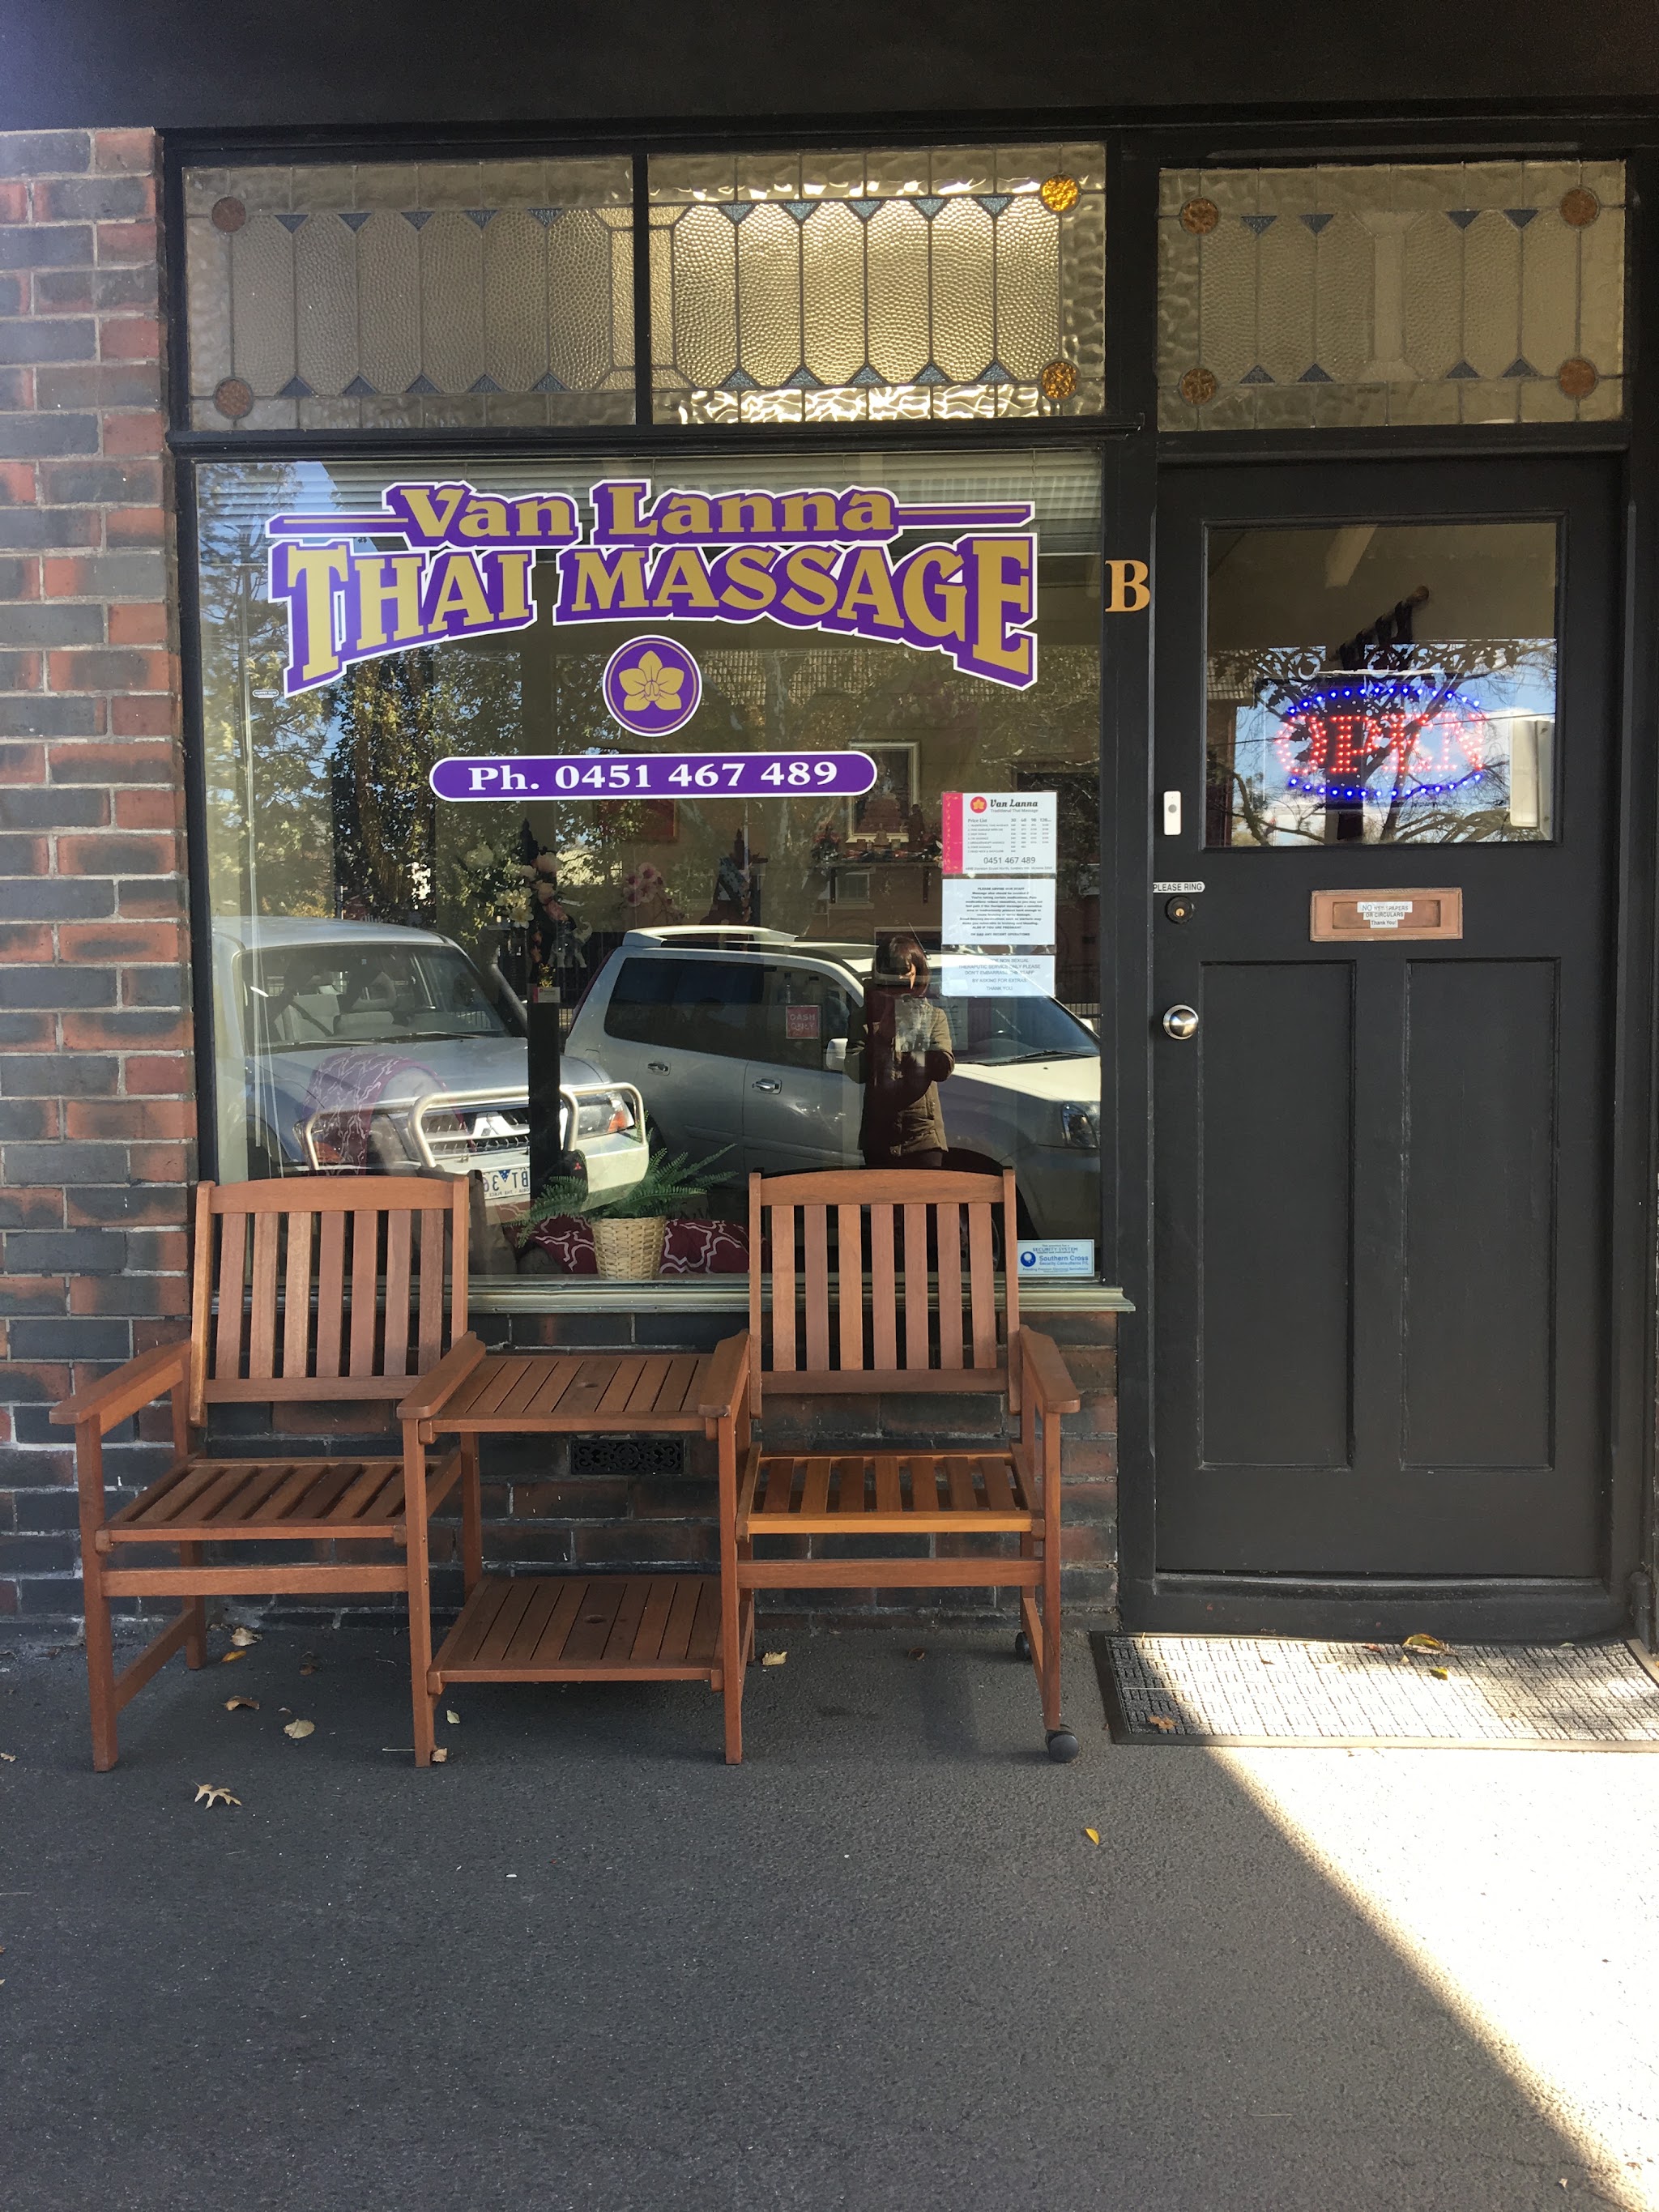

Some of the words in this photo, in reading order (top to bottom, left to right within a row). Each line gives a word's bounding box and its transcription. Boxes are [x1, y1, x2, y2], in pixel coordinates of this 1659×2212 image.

[399, 488, 574, 539] Van
[608, 485, 894, 536] Lanna
[1103, 559, 1151, 613] B
[287, 543, 531, 682] THAI
[570, 539, 1030, 676] MASSAGE
[1274, 713, 1490, 775] OPEN
[468, 765, 540, 791] Ph.
[555, 764, 652, 790] 0451
[667, 762, 746, 788] 467
[761, 761, 838, 786] 489
[990, 799, 1008, 808] Van
[1009, 799, 1038, 808] Lanna
[983, 856, 1002, 864] 0451
[1004, 856, 1019, 864] 467
[1153, 883, 1182, 892] PLEASE
[1184, 883, 1202, 891] RING
[790, 1013, 816, 1021] CASH
